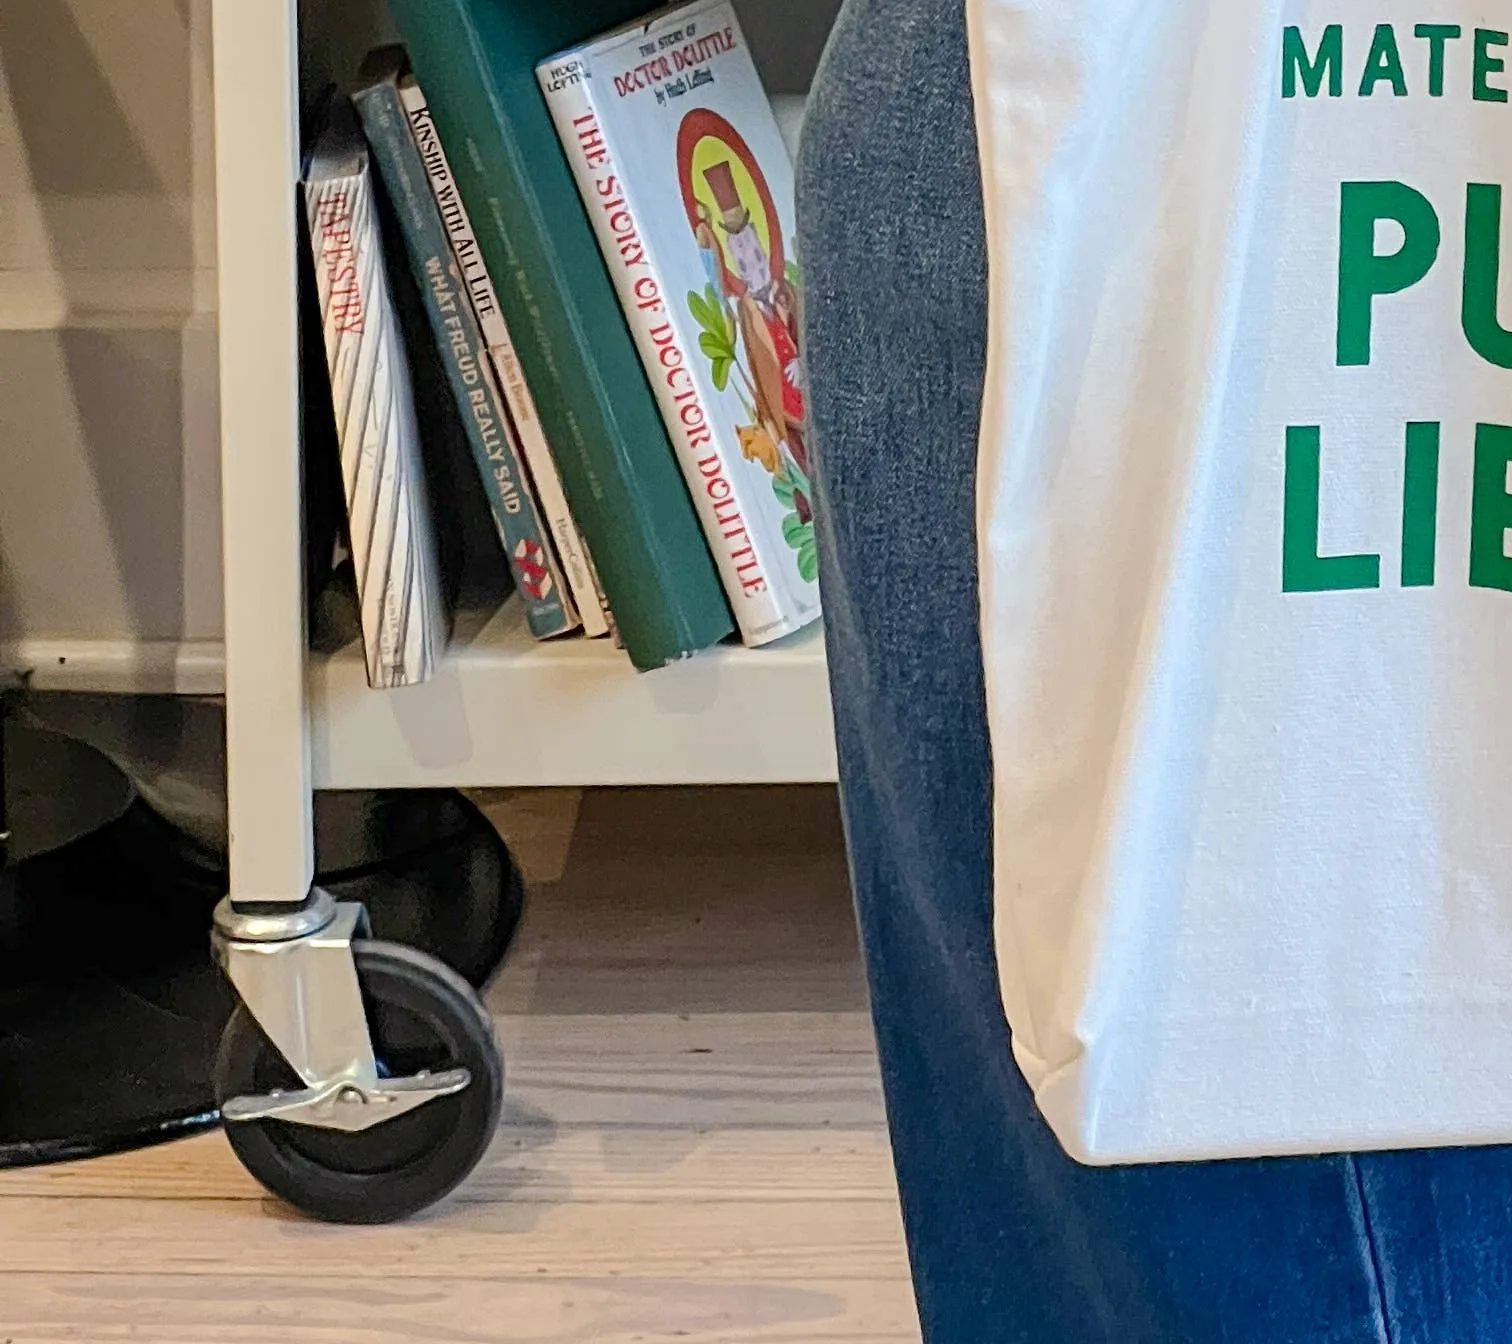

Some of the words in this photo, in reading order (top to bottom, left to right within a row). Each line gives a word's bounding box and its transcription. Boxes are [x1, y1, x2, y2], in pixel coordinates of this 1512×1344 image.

[612, 55, 673, 98] DOCTOR
[672, 25, 738, 73] DOLITTLE
[317, 192, 365, 335] TAPESTRY
[409, 105, 448, 182] KINSHIP
[437, 183, 466, 233] WITH
[454, 237, 481, 272] ALL
[468, 273, 496, 321] LIFE
[425, 255, 456, 321] WHAT
[444, 315, 478, 386] FREUD
[467, 388, 506, 464] REALLY
[494, 461, 522, 514] SAID
[572, 106, 607, 170] THE
[596, 172, 650, 268] STORY
[633, 277, 664, 315] OF
[650, 326, 713, 450] DOCTOR
[697, 452, 769, 599] DOLITTLE
